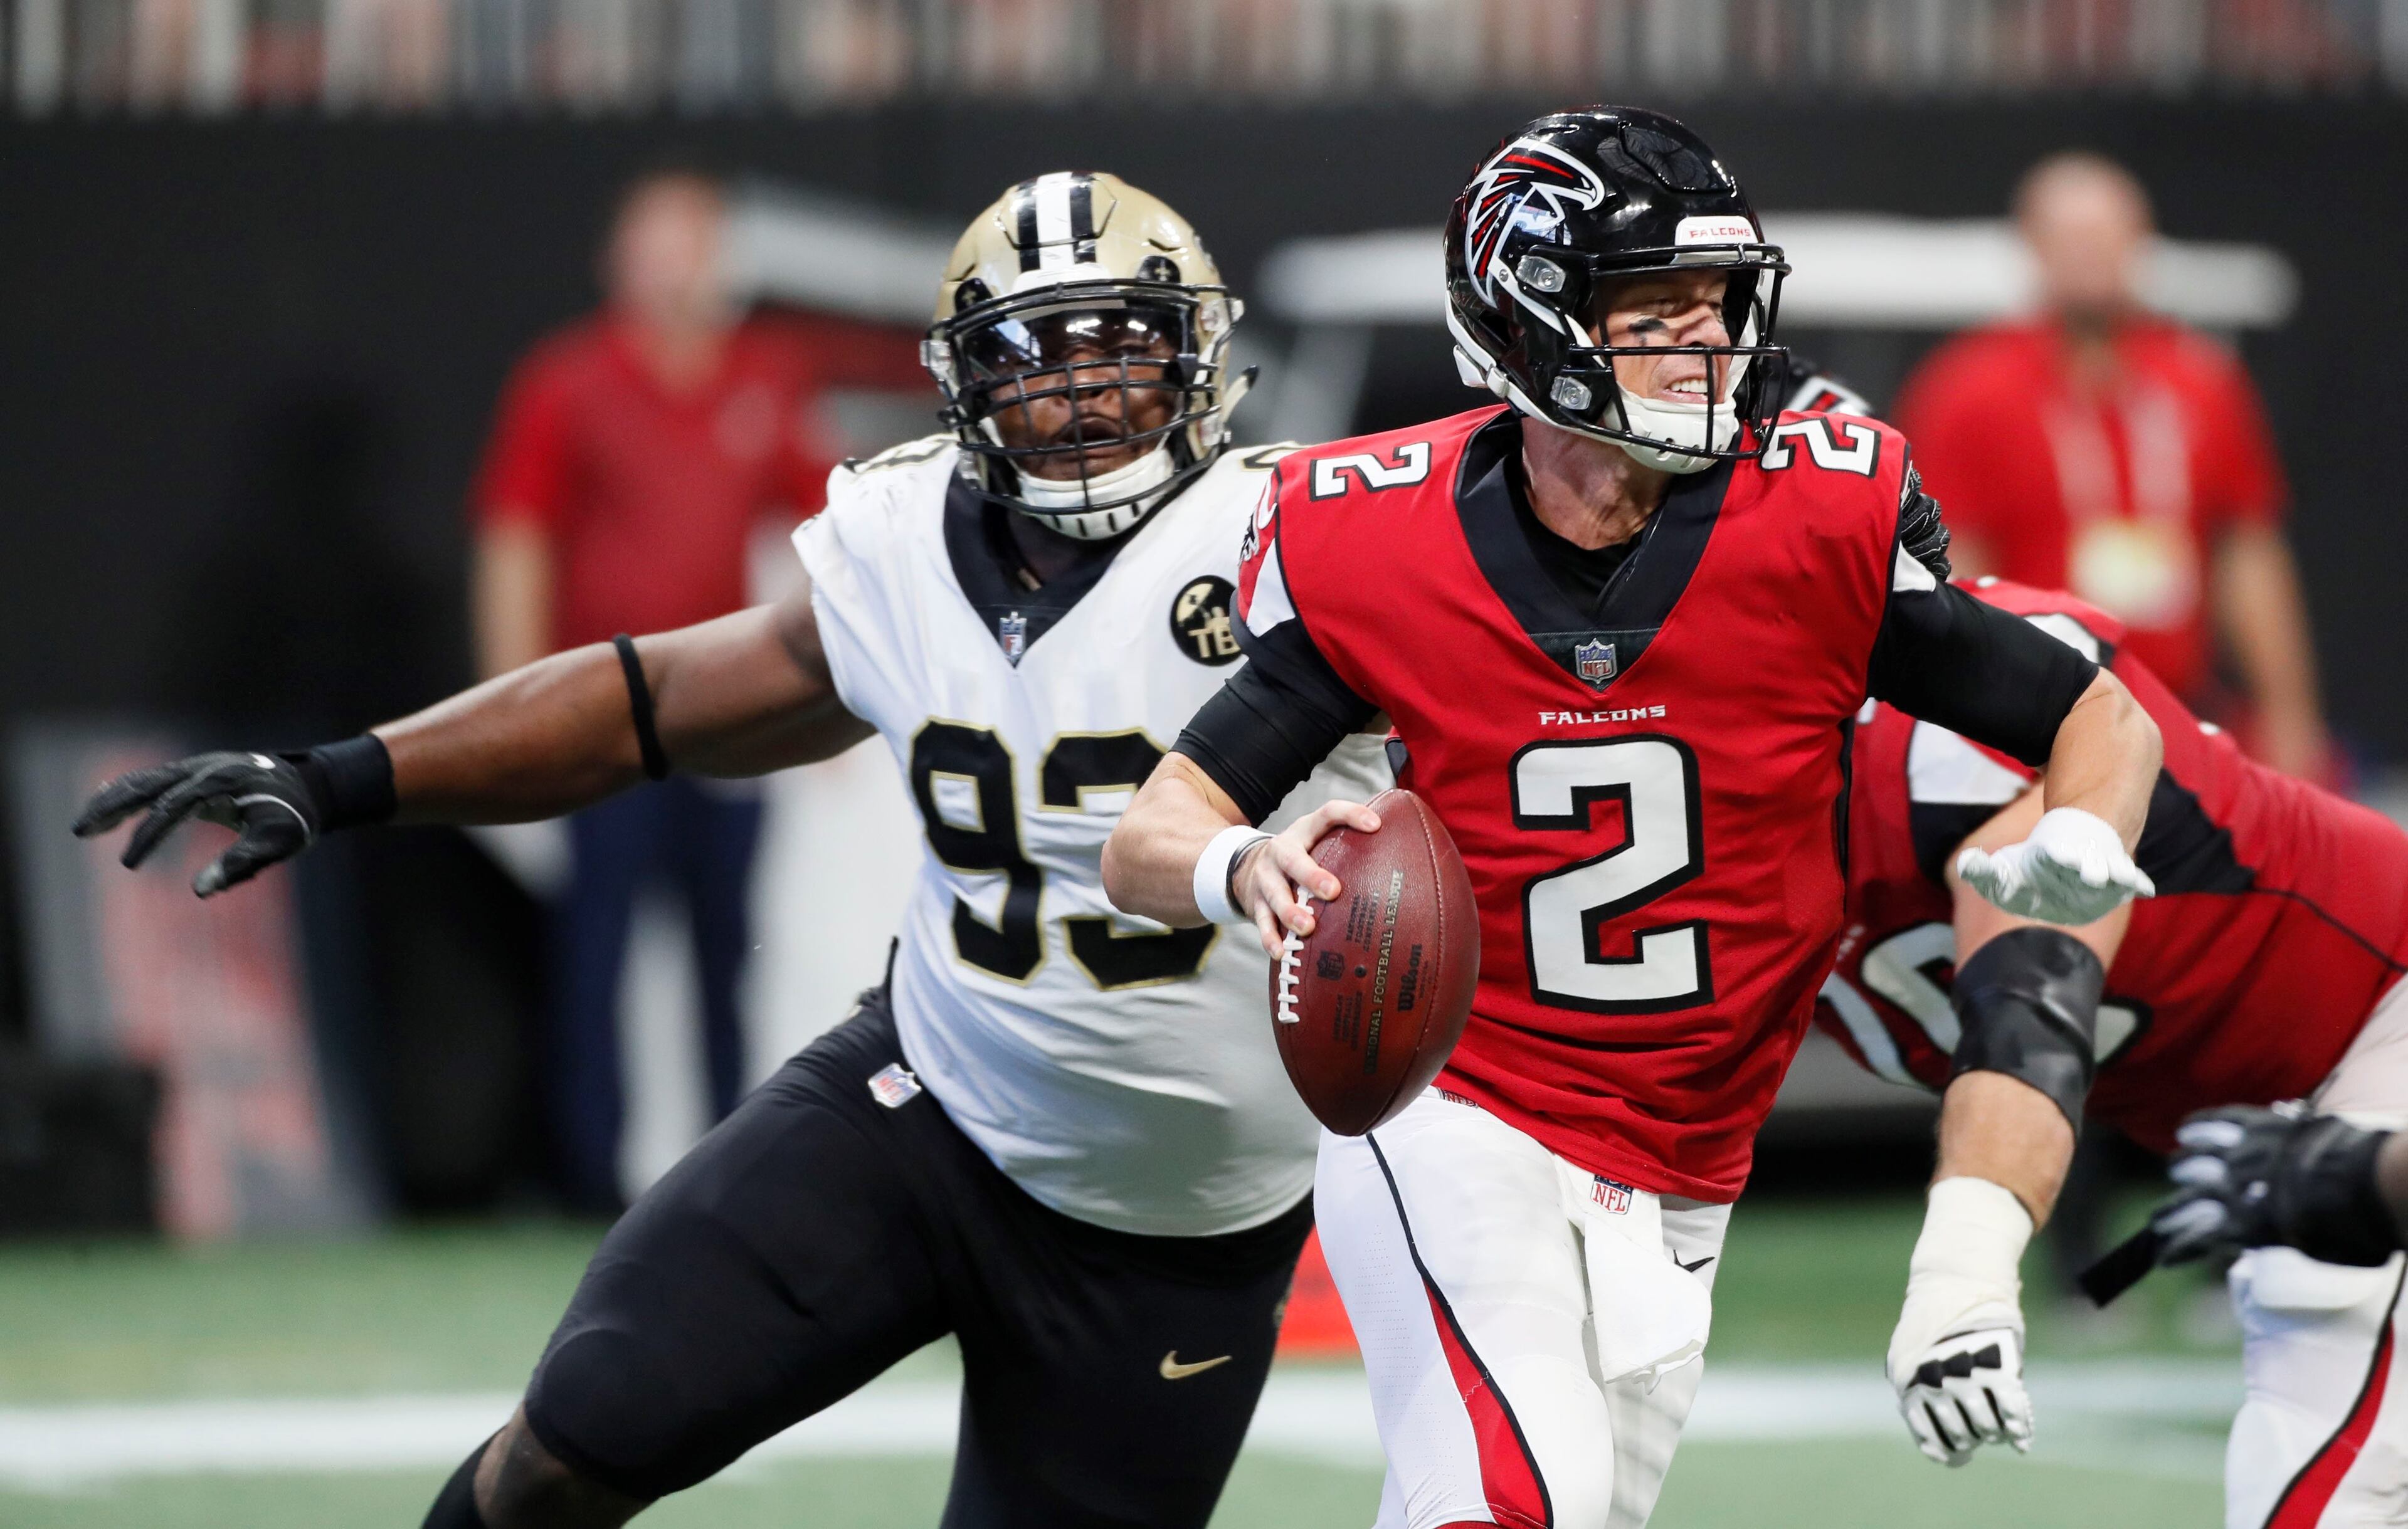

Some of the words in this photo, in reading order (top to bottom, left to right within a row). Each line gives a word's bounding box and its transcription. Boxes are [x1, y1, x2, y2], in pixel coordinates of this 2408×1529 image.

[1689, 227, 1751, 239] FALCONS
[1309, 441, 1432, 502] 2
[1761, 416, 1879, 479] 2
[1538, 705, 1666, 725] FALCONS
[909, 713, 1222, 991] 93
[1508, 732, 1715, 1016] 2
[1373, 930, 1394, 1004] FOOTBALL
[1398, 943, 1422, 1012] Wilson
[1592, 1184, 1626, 1212] NFL
